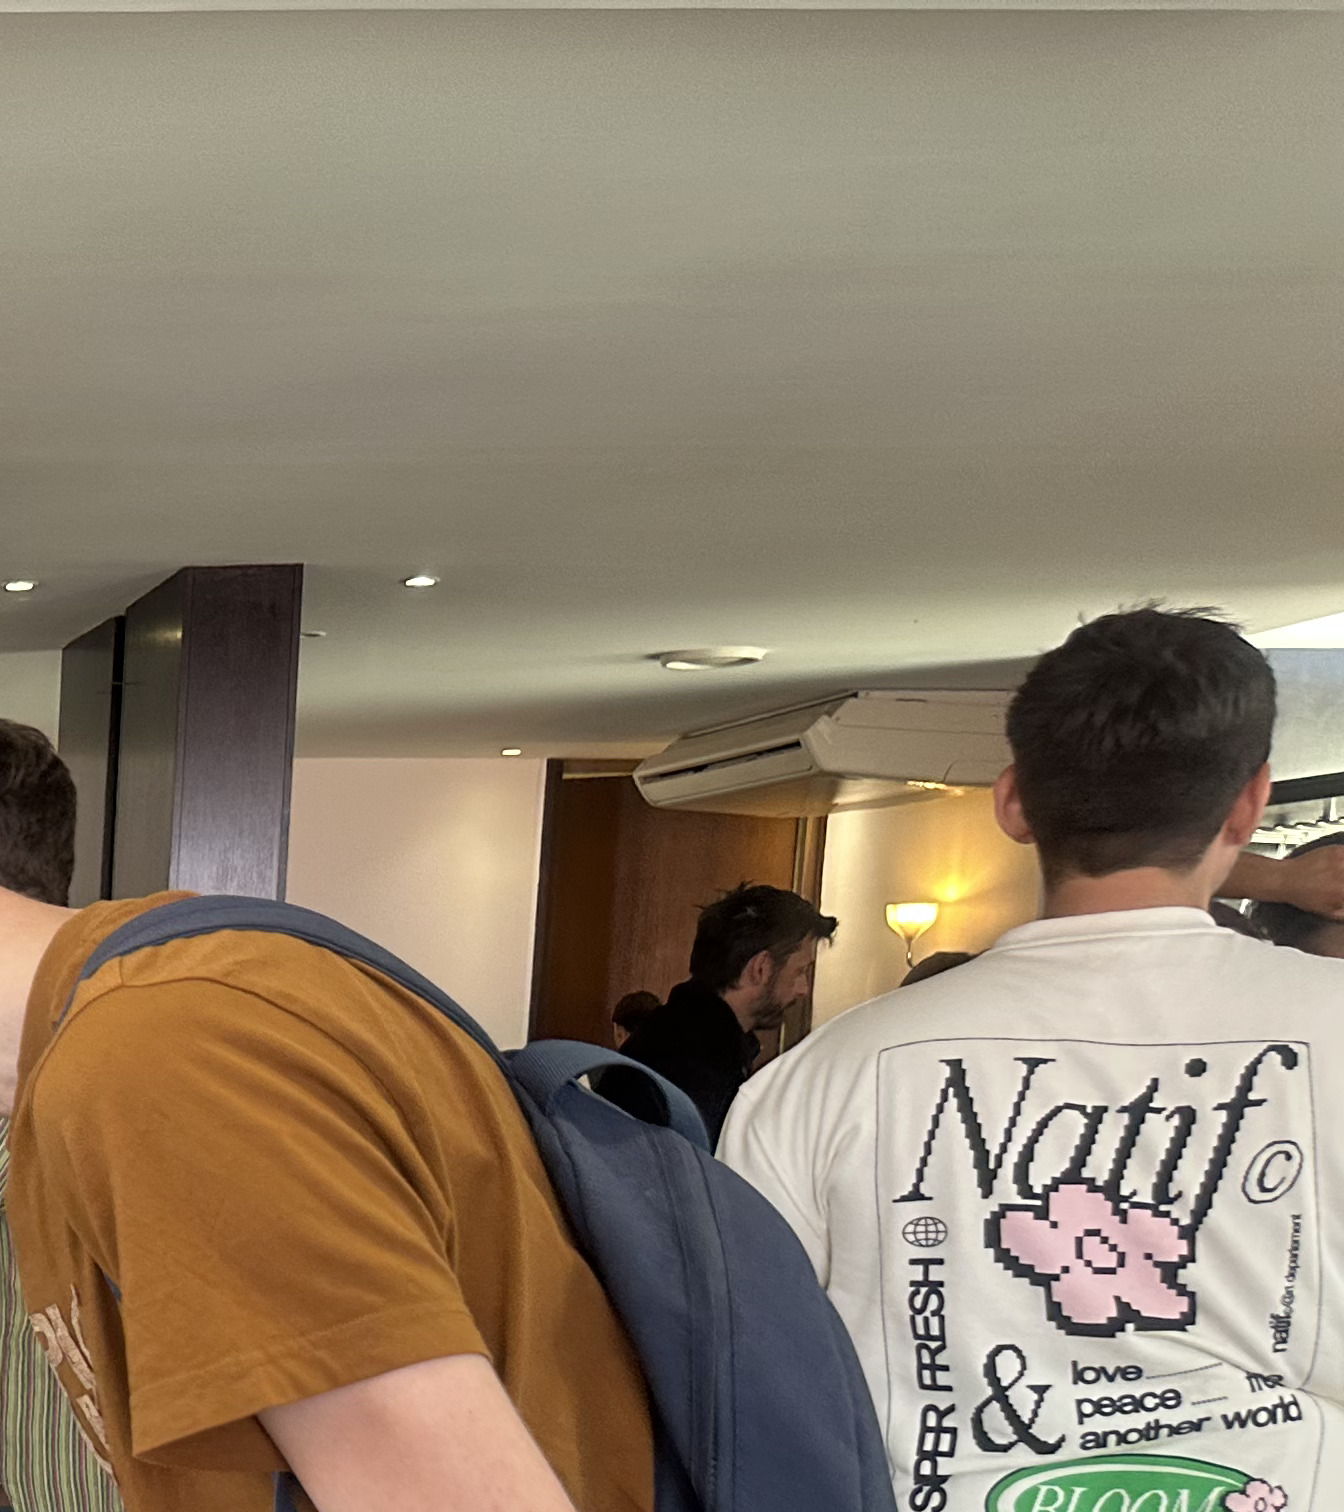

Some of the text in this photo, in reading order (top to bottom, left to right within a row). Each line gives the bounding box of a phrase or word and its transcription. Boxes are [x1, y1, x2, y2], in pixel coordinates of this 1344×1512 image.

[892, 1044, 1299, 1232] Natif
[908, 1257, 954, 1392] FRESH
[1071, 1360, 1143, 1385] love
[1075, 1388, 1182, 1425] peace
[1079, 1393, 1303, 1451] another world
